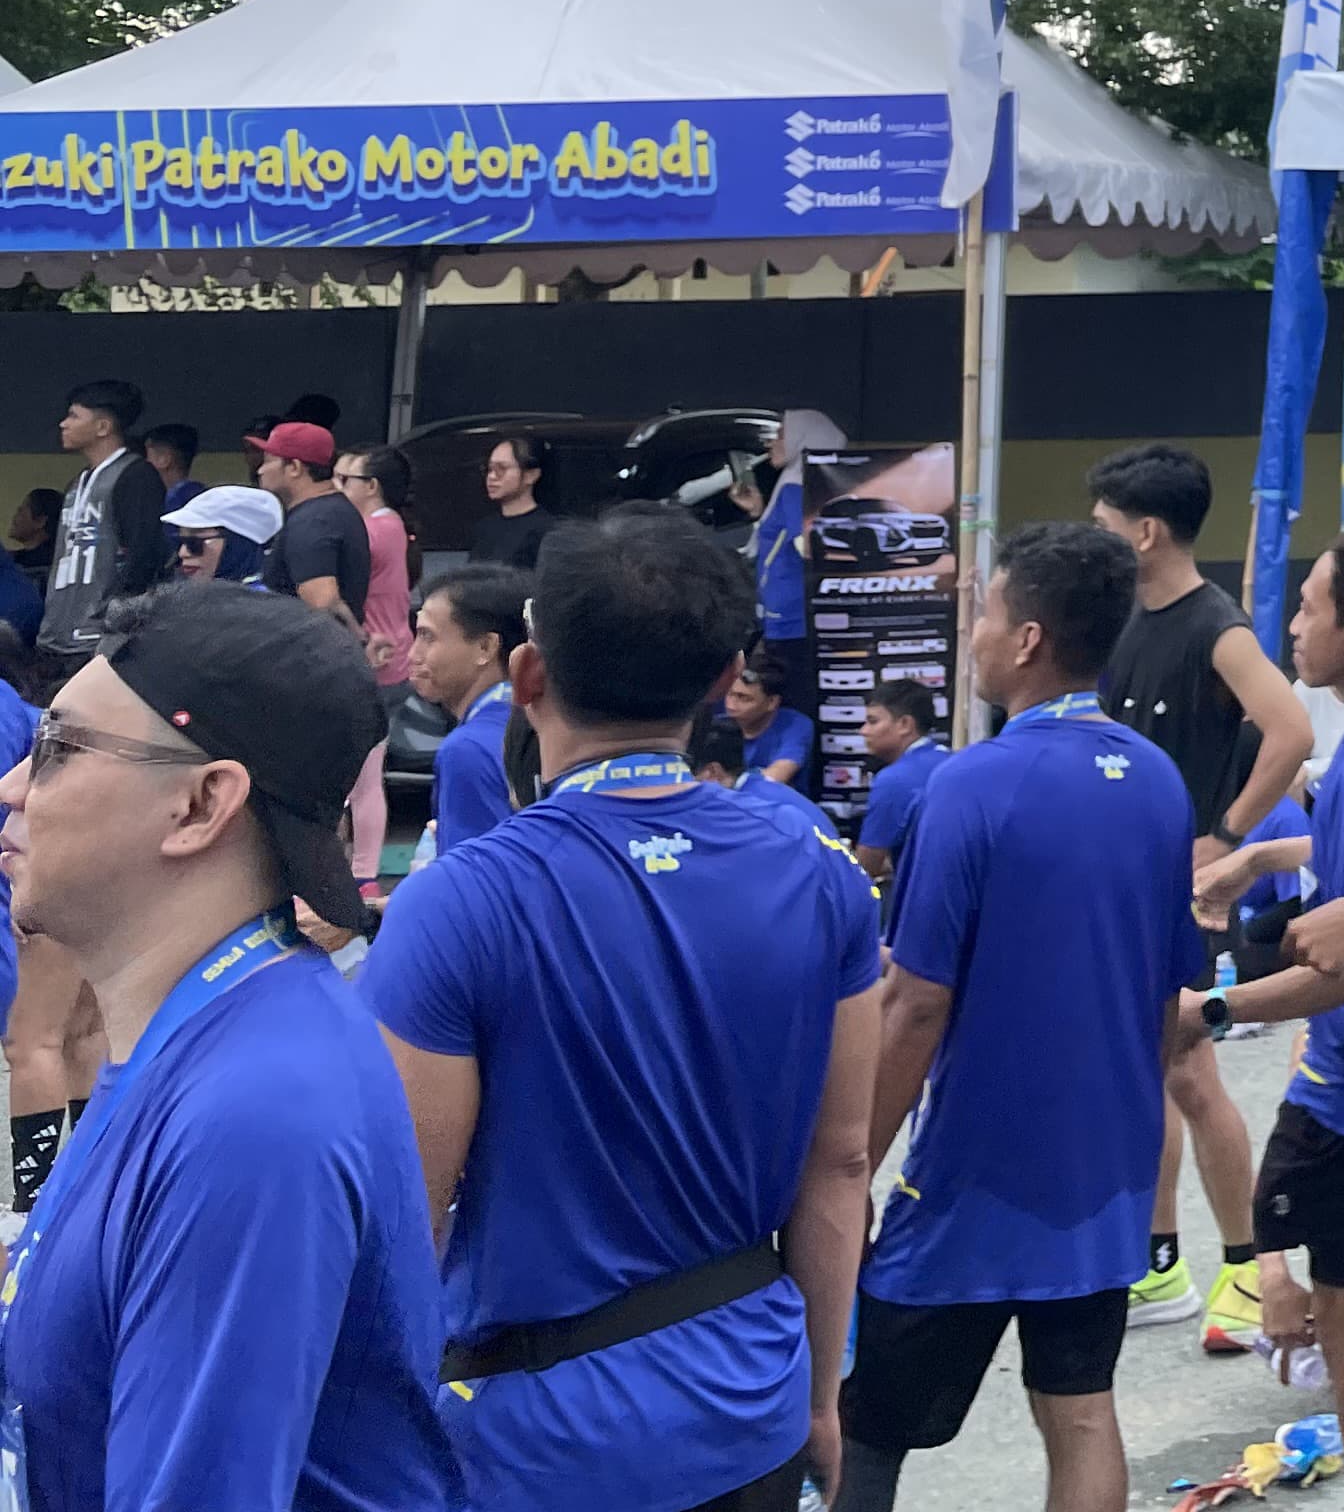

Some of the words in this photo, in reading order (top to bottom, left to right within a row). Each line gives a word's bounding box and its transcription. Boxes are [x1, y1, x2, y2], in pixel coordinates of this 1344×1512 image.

[132, 130, 346, 192] Patrako
[363, 132, 540, 183] Motor
[555, 119, 710, 180] Abadi
[819, 575, 938, 595] FRONX
